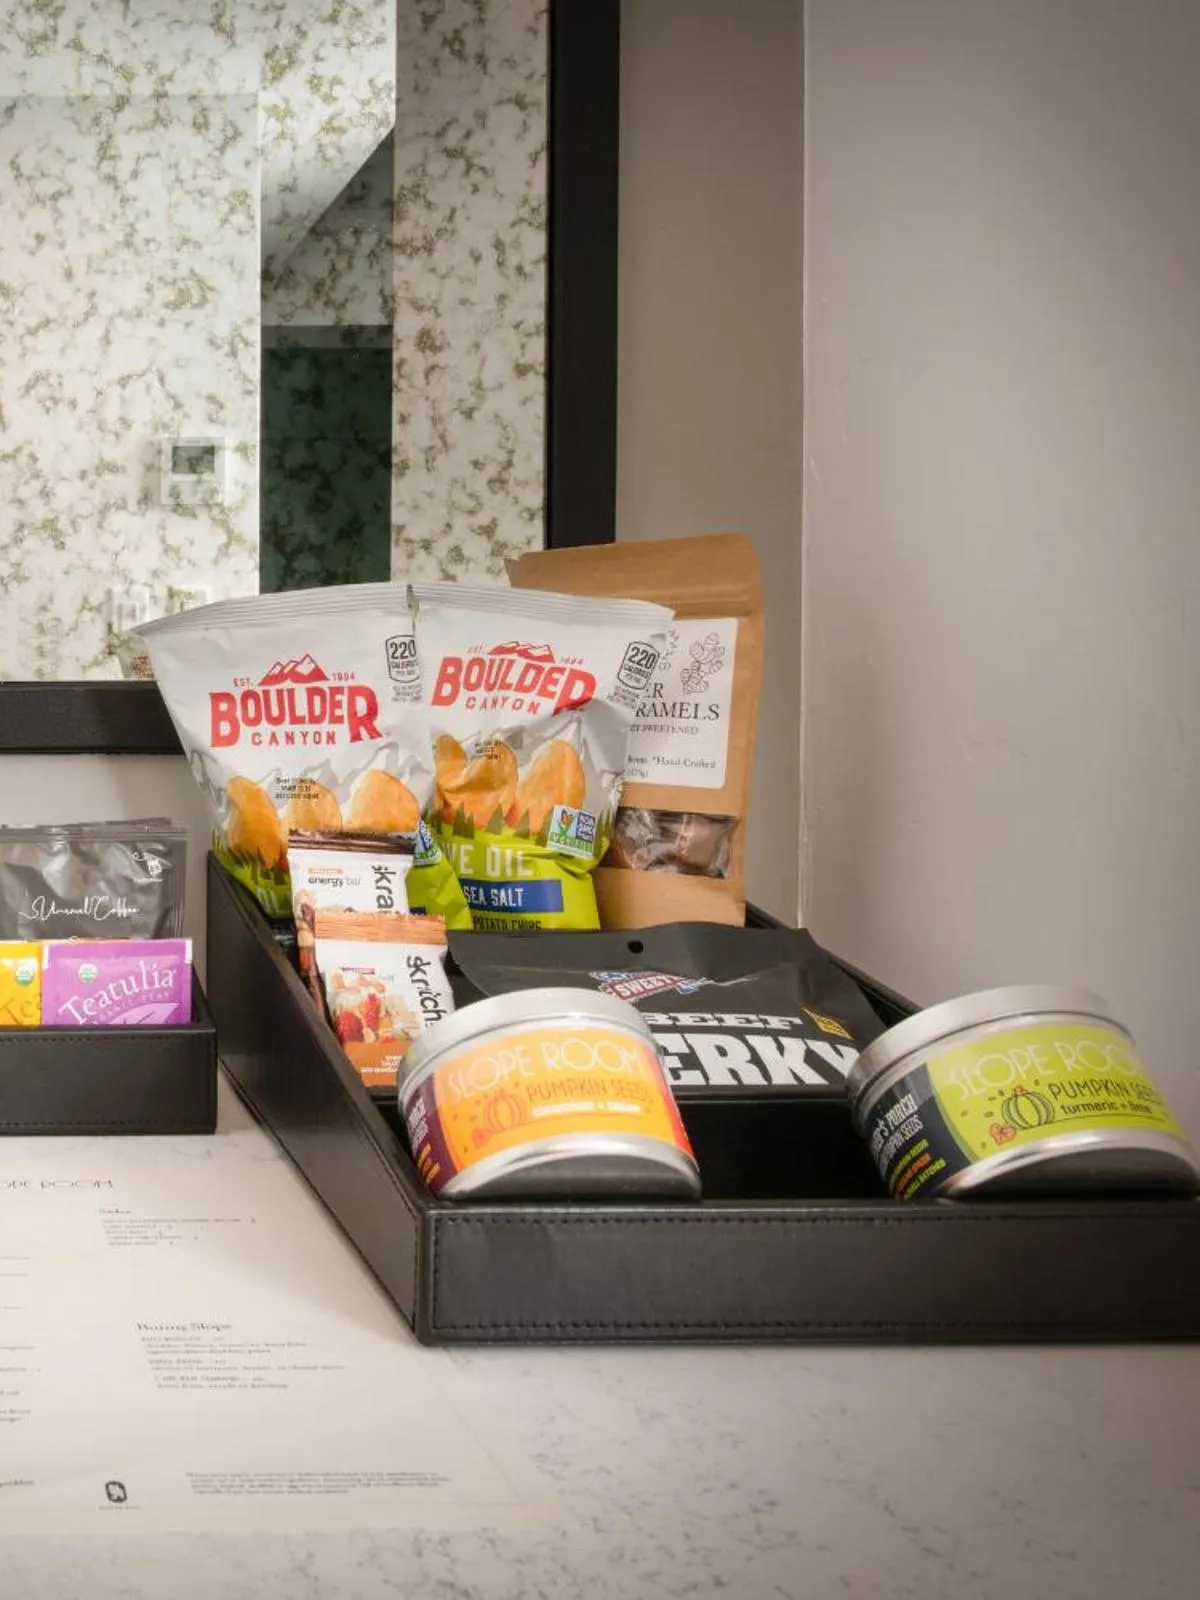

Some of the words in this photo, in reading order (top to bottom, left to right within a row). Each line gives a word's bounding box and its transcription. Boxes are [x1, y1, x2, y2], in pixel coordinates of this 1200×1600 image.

[390, 640, 416, 660] 220
[628, 646, 657, 669] 220
[233, 677, 254, 688] EST.
[208, 685, 383, 748] BOULDER
[465, 696, 541, 715] CANYON
[635, 702, 720, 720] RAMELS
[251, 730, 336, 746] CANYON
[486, 845, 533, 878] OIL
[308, 877, 343, 888] energy
[463, 886, 487, 905] SEA
[491, 888, 524, 908] SALT
[58, 960, 177, 1024] Teatulia
[653, 1033, 860, 1085] ERKY
[449, 1045, 535, 1105] SLOPE
[541, 1038, 646, 1077] ROOM
[951, 1045, 1056, 1101] SLOPE
[527, 1079, 607, 1102] PUMPKIN
[1048, 1078, 1131, 1101] PUMPKIN
[1060, 1100, 1119, 1115] turmeric
